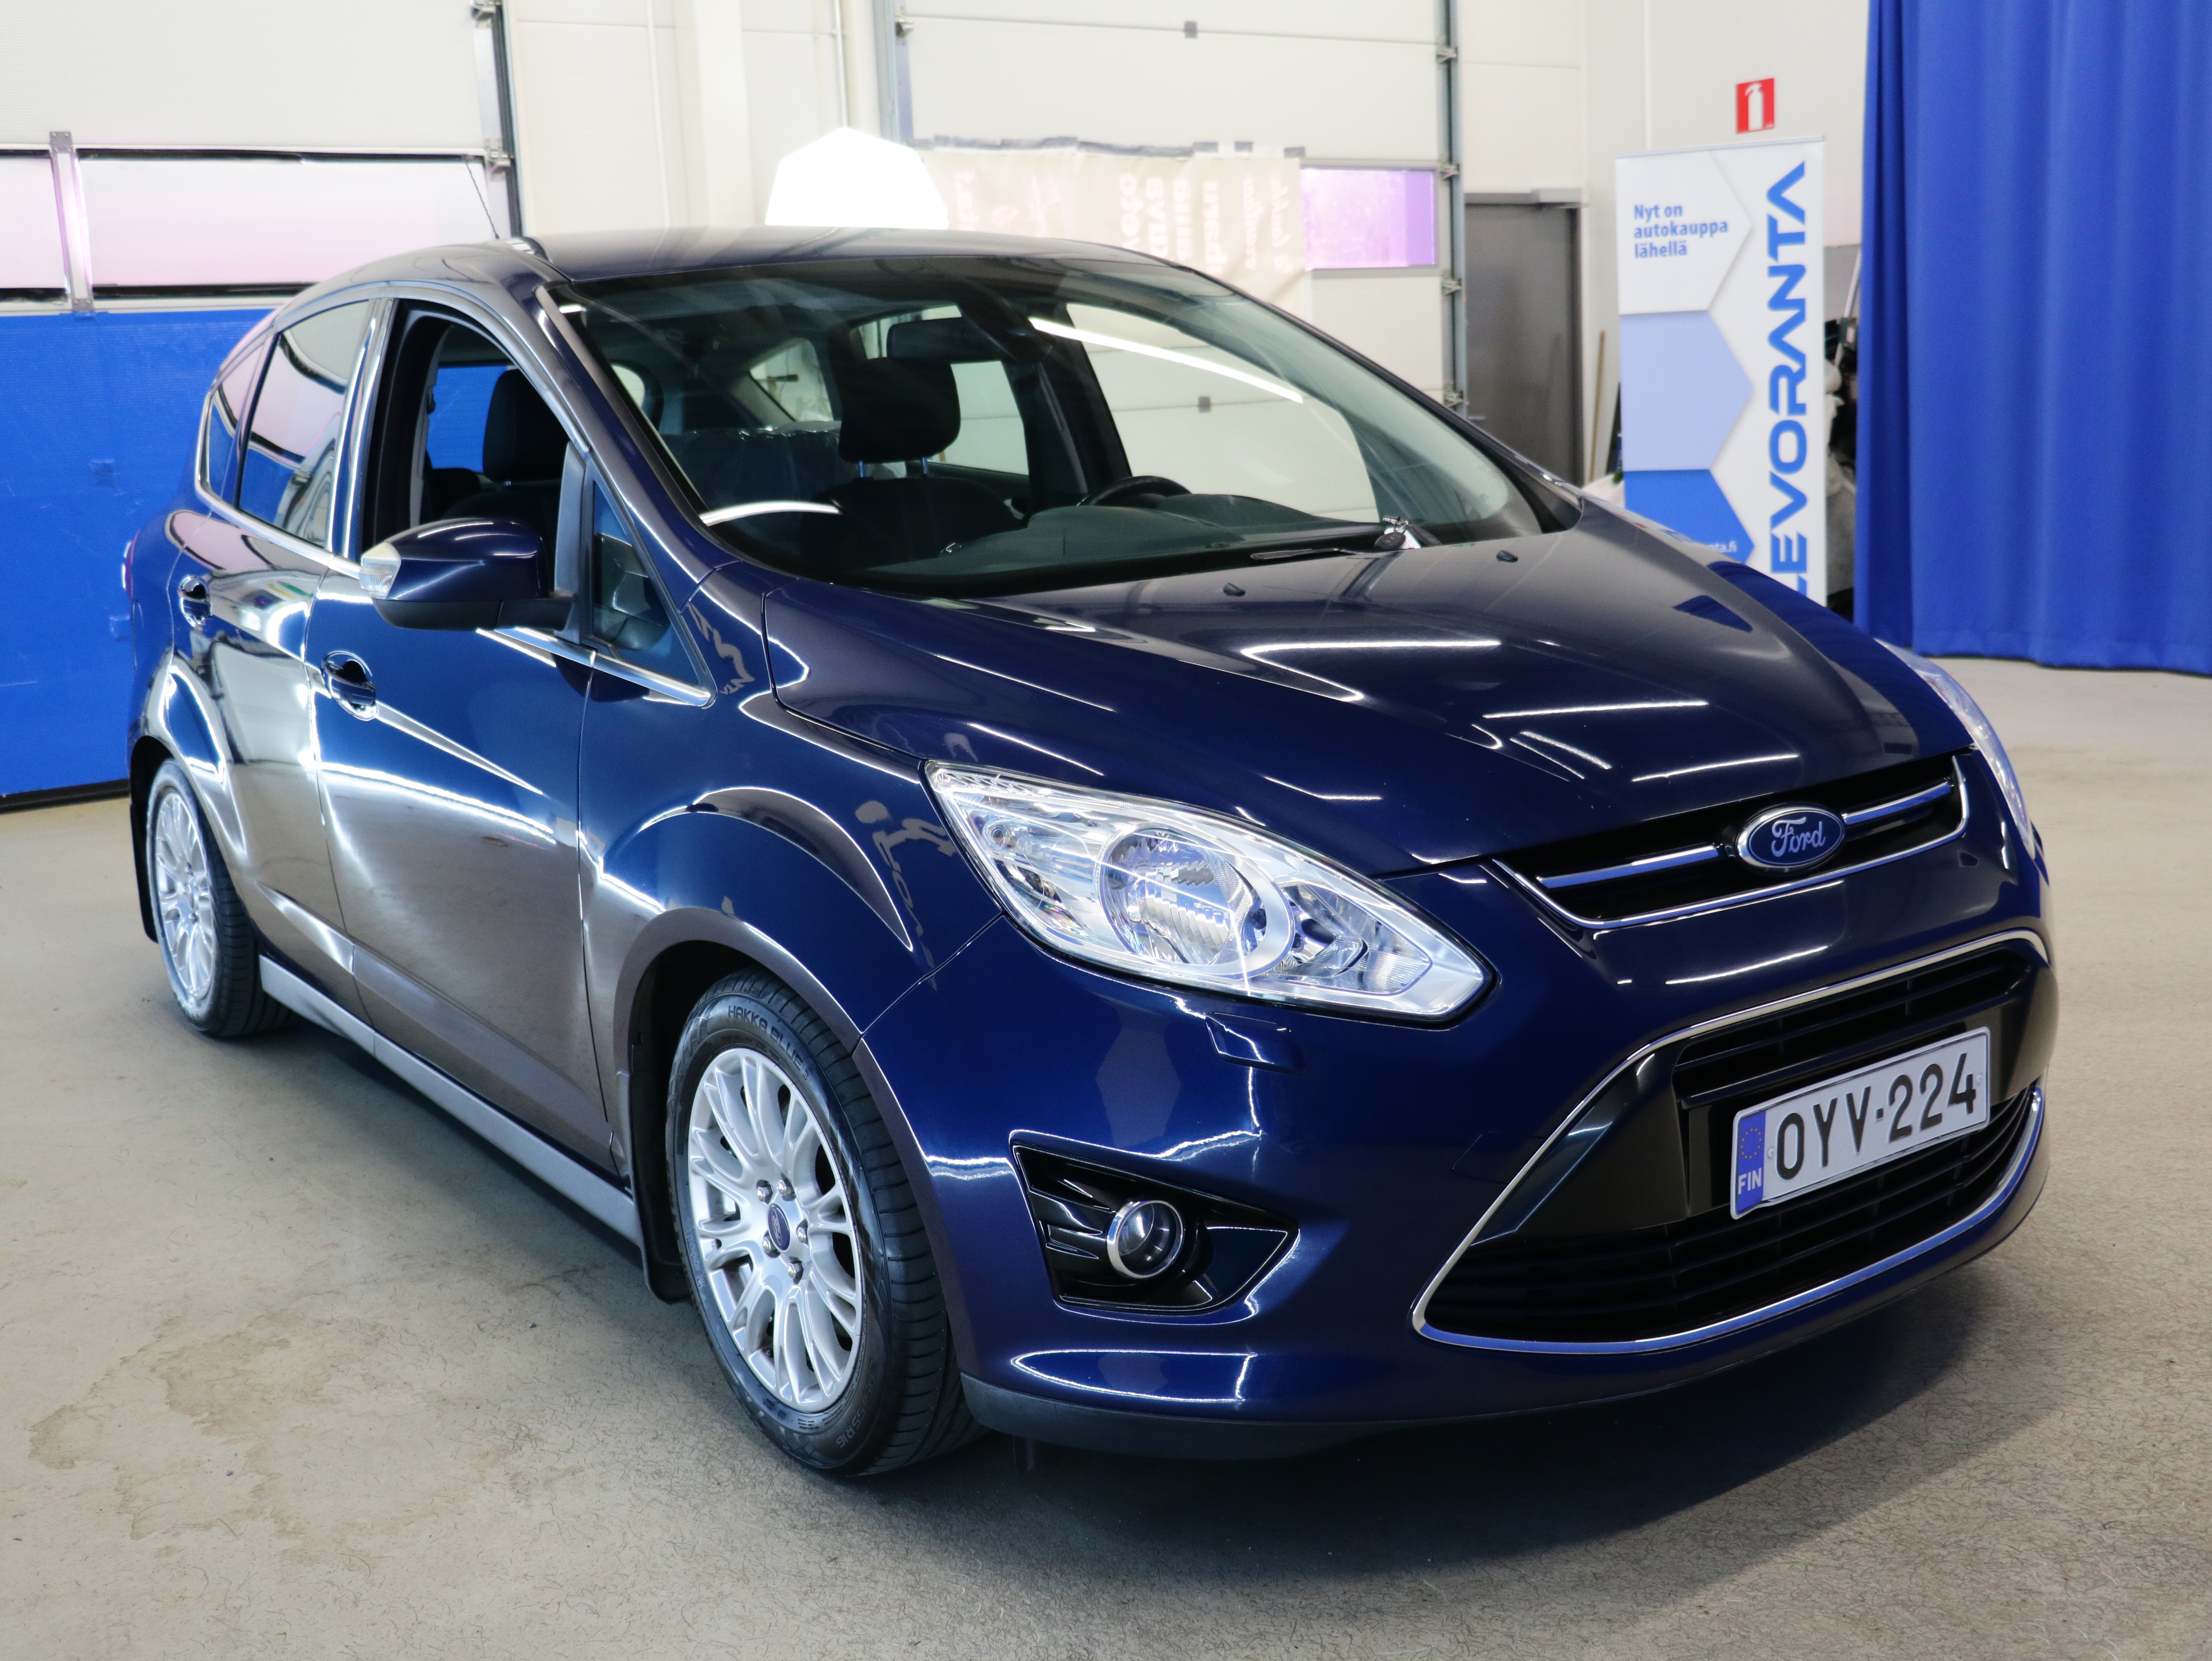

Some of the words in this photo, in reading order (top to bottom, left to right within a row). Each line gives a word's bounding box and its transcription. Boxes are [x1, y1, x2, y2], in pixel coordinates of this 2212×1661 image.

[1634, 205, 1660, 222] Nyt
[1664, 205, 1683, 217] on
[1634, 220, 1728, 238] autokauppa
[1635, 241, 1687, 258] lähellä
[1766, 160, 1808, 597] EVORANTA
[1708, 540, 1737, 552] ta.fi
[1771, 817, 1826, 857] Ford
[728, 1005, 768, 1034] HAKKA
[771, 1025, 804, 1071] BLUE
[1776, 1053, 1976, 1180] OYV-224
[1738, 1168, 1762, 1195] FIN
